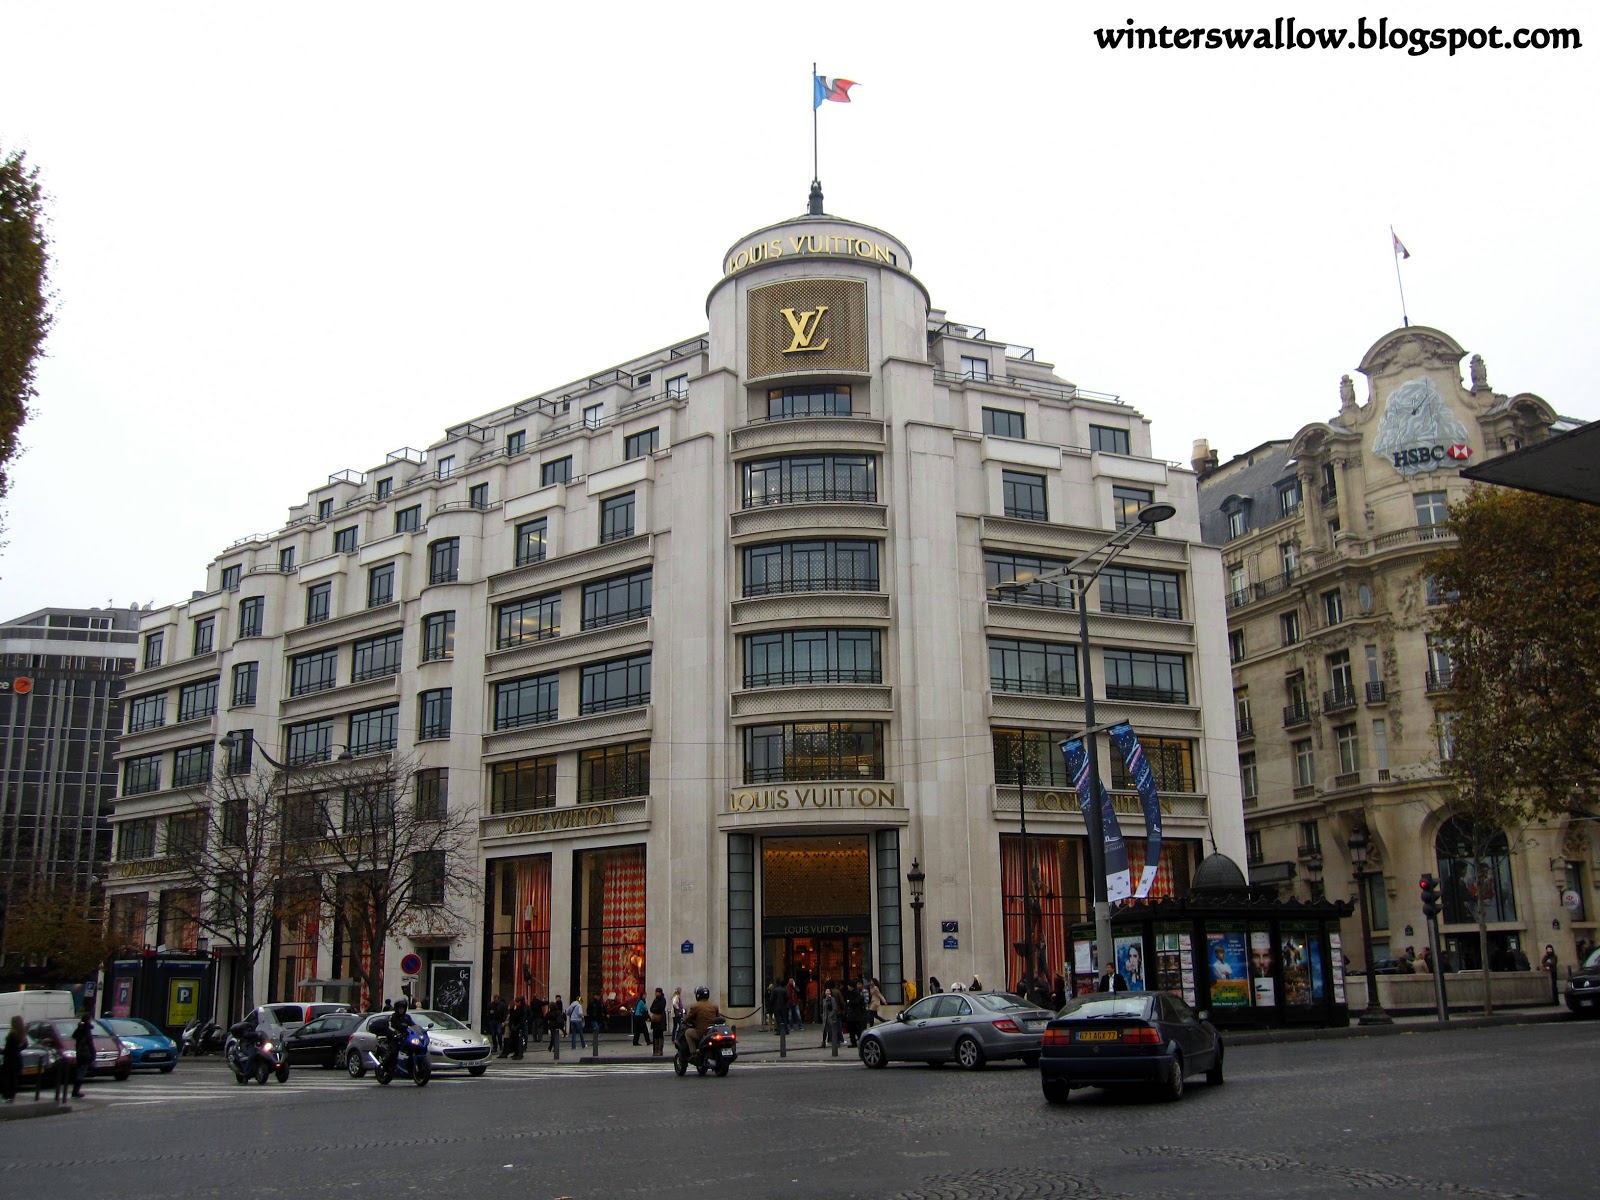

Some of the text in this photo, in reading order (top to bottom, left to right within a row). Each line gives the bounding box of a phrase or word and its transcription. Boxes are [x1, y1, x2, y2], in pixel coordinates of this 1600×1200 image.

[729, 235, 890, 274] LOUIS VUITTON
[780, 305, 830, 354] LV
[1392, 445, 1446, 468] HSBC
[730, 787, 895, 812] LOUIS VUITTON
[506, 806, 615, 835] LOUIS VUITTON
[784, 925, 849, 935] LOUIS VUITTON
[459, 969, 469, 980] Gc
[121, 989, 128, 1002] P
[180, 989, 190, 1002] P
